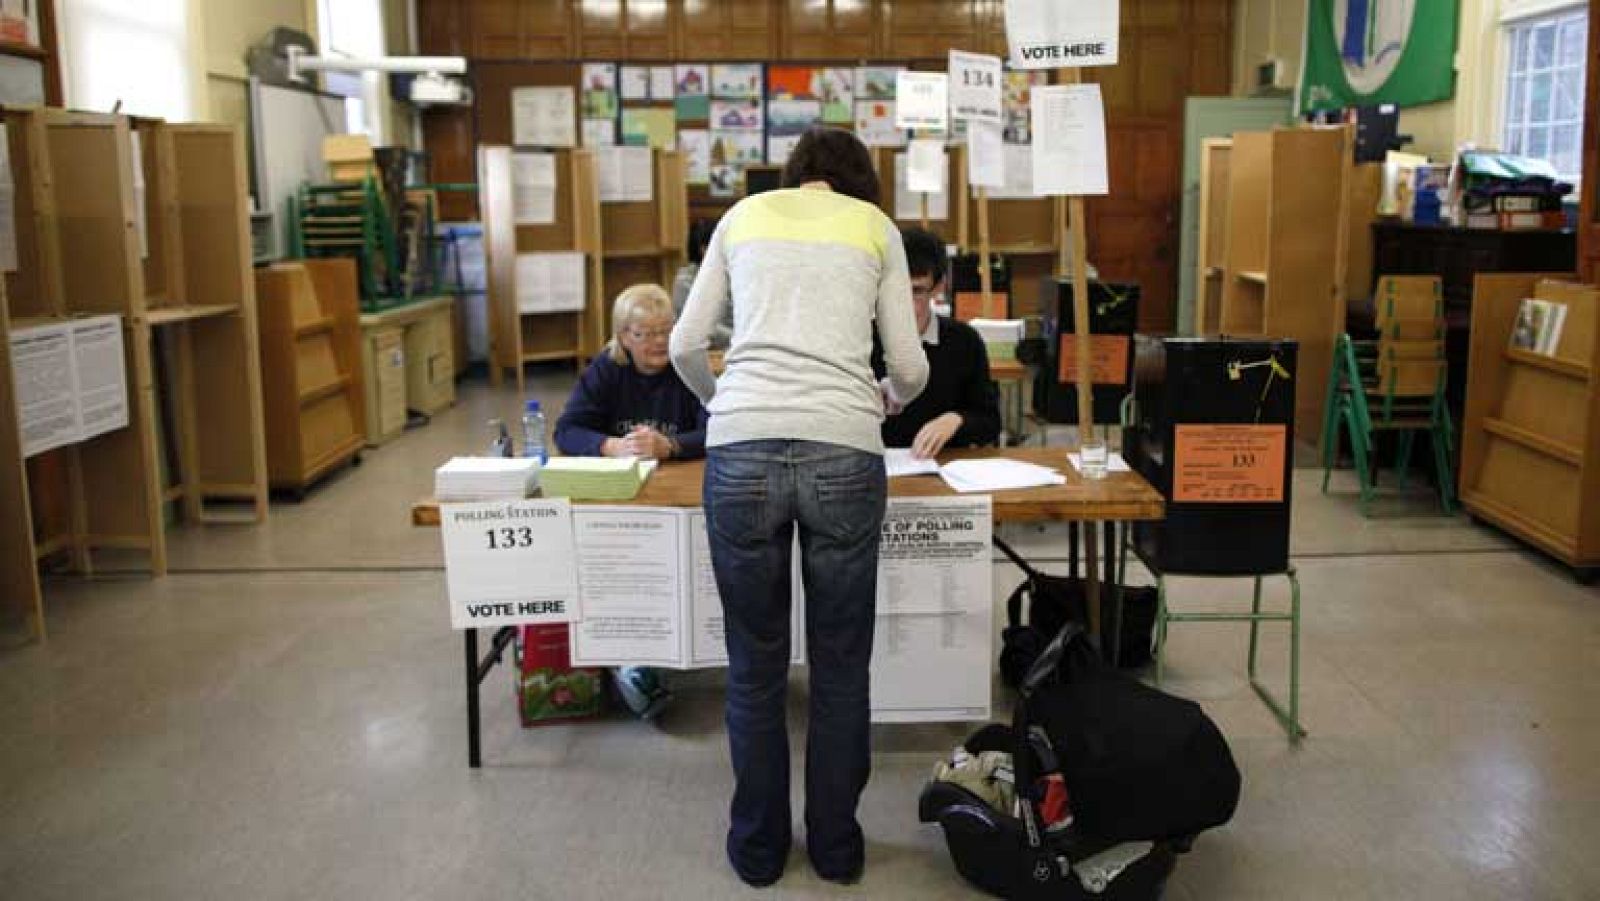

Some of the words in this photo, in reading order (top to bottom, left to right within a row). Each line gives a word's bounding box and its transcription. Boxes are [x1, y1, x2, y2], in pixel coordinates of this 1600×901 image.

[1021, 45, 1060, 60] VOTE
[1064, 42, 1105, 58] HERE
[454, 508, 505, 521] POLLING
[507, 505, 558, 519] STATION
[895, 523, 912, 533] OF
[916, 520, 974, 531] POLLING
[486, 526, 534, 549] 133
[466, 602, 515, 618] VOTE
[518, 600, 566, 615] HERE
